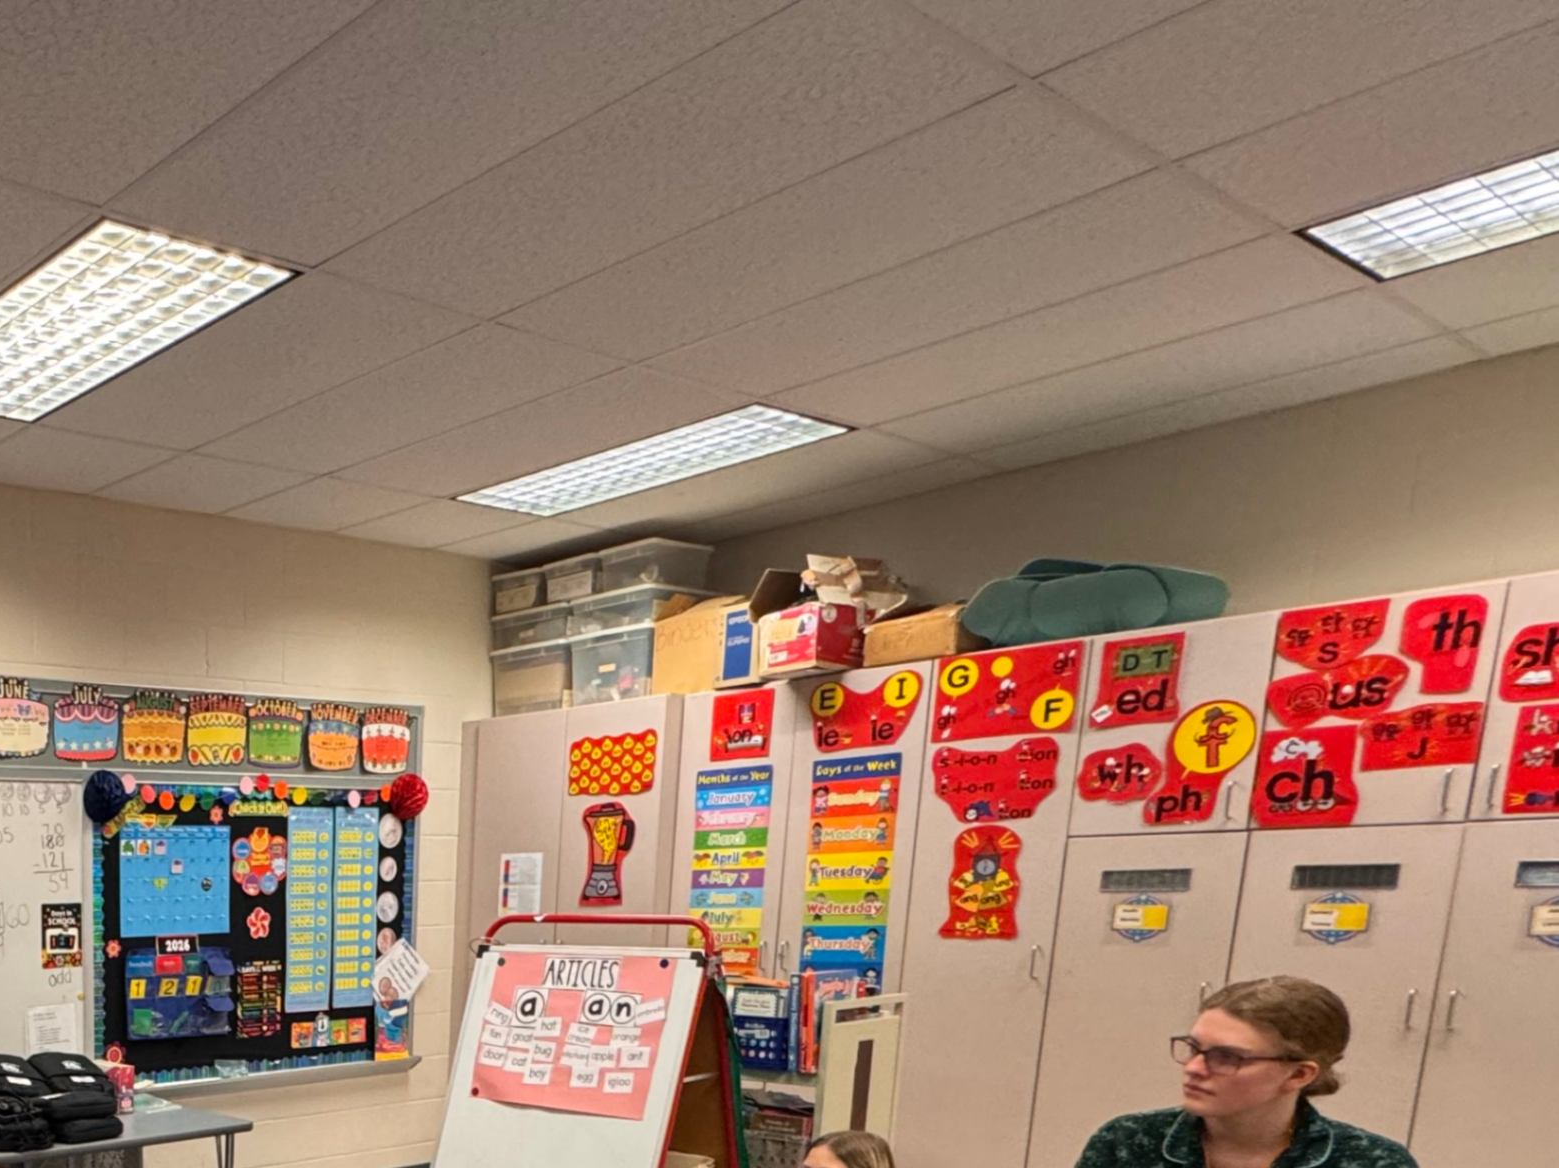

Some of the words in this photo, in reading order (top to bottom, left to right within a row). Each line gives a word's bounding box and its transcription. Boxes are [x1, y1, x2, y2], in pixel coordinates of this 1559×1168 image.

[1433, 610, 1480, 651] th
[1053, 651, 1076, 676] gh
[1122, 653, 1140, 672] D
[1152, 651, 1169, 668] T
[947, 665, 971, 688] G
[0, 681, 30, 699] JUNE
[74, 687, 103, 705] JULY
[819, 689, 837, 710] E
[895, 678, 908, 700] I
[995, 681, 1015, 704] gh
[1116, 679, 1169, 714] ed
[1329, 677, 1391, 710] us
[136, 693, 176, 710] AUGUST
[189, 697, 246, 714] SEPTEMBER
[256, 702, 298, 718] OCTOBER
[311, 707, 359, 724] NOVEMBER
[364, 708, 409, 725] DECEMBER
[1043, 699, 1064, 723] F
[817, 722, 840, 747] ie
[871, 714, 894, 741] ie
[1407, 738, 1427, 760] J
[816, 762, 842, 777] Days
[867, 759, 896, 772] Week
[1097, 754, 1145, 785] wh
[698, 772, 730, 785] Months
[750, 770, 770, 781] Year
[1265, 759, 1335, 804] ch
[707, 790, 754, 806] January
[828, 790, 880, 806] Sunday
[1154, 785, 1202, 822] ph
[2, 803, 14, 817] 10
[19, 803, 30, 816] 10
[708, 831, 746, 845] March
[822, 826, 877, 842] Monday
[712, 851, 740, 865] April
[709, 871, 737, 886] May
[819, 864, 874, 881] Tuesday
[6, 902, 30, 930] 60
[806, 900, 884, 916] Wednesday
[707, 910, 734, 927] July
[165, 940, 190, 952] 2026
[809, 936, 871, 952] Thursday
[49, 970, 72, 988] odd
[543, 959, 619, 988] ARTICLES
[164, 982, 175, 993] 2
[519, 996, 537, 1017] a
[490, 1008, 509, 1024] ring
[489, 1030, 503, 1040] fan
[541, 1021, 557, 1032] hat
[512, 1032, 533, 1043] goat
[567, 1034, 591, 1043] cream
[483, 1049, 505, 1061] door
[534, 1044, 553, 1060] bug
[591, 1051, 615, 1063] apple
[626, 1050, 643, 1062] ant
[511, 1056, 528, 1067] cat
[528, 1068, 547, 1082] boy
[576, 1072, 594, 1084] egg
[607, 1076, 631, 1089] igloo
